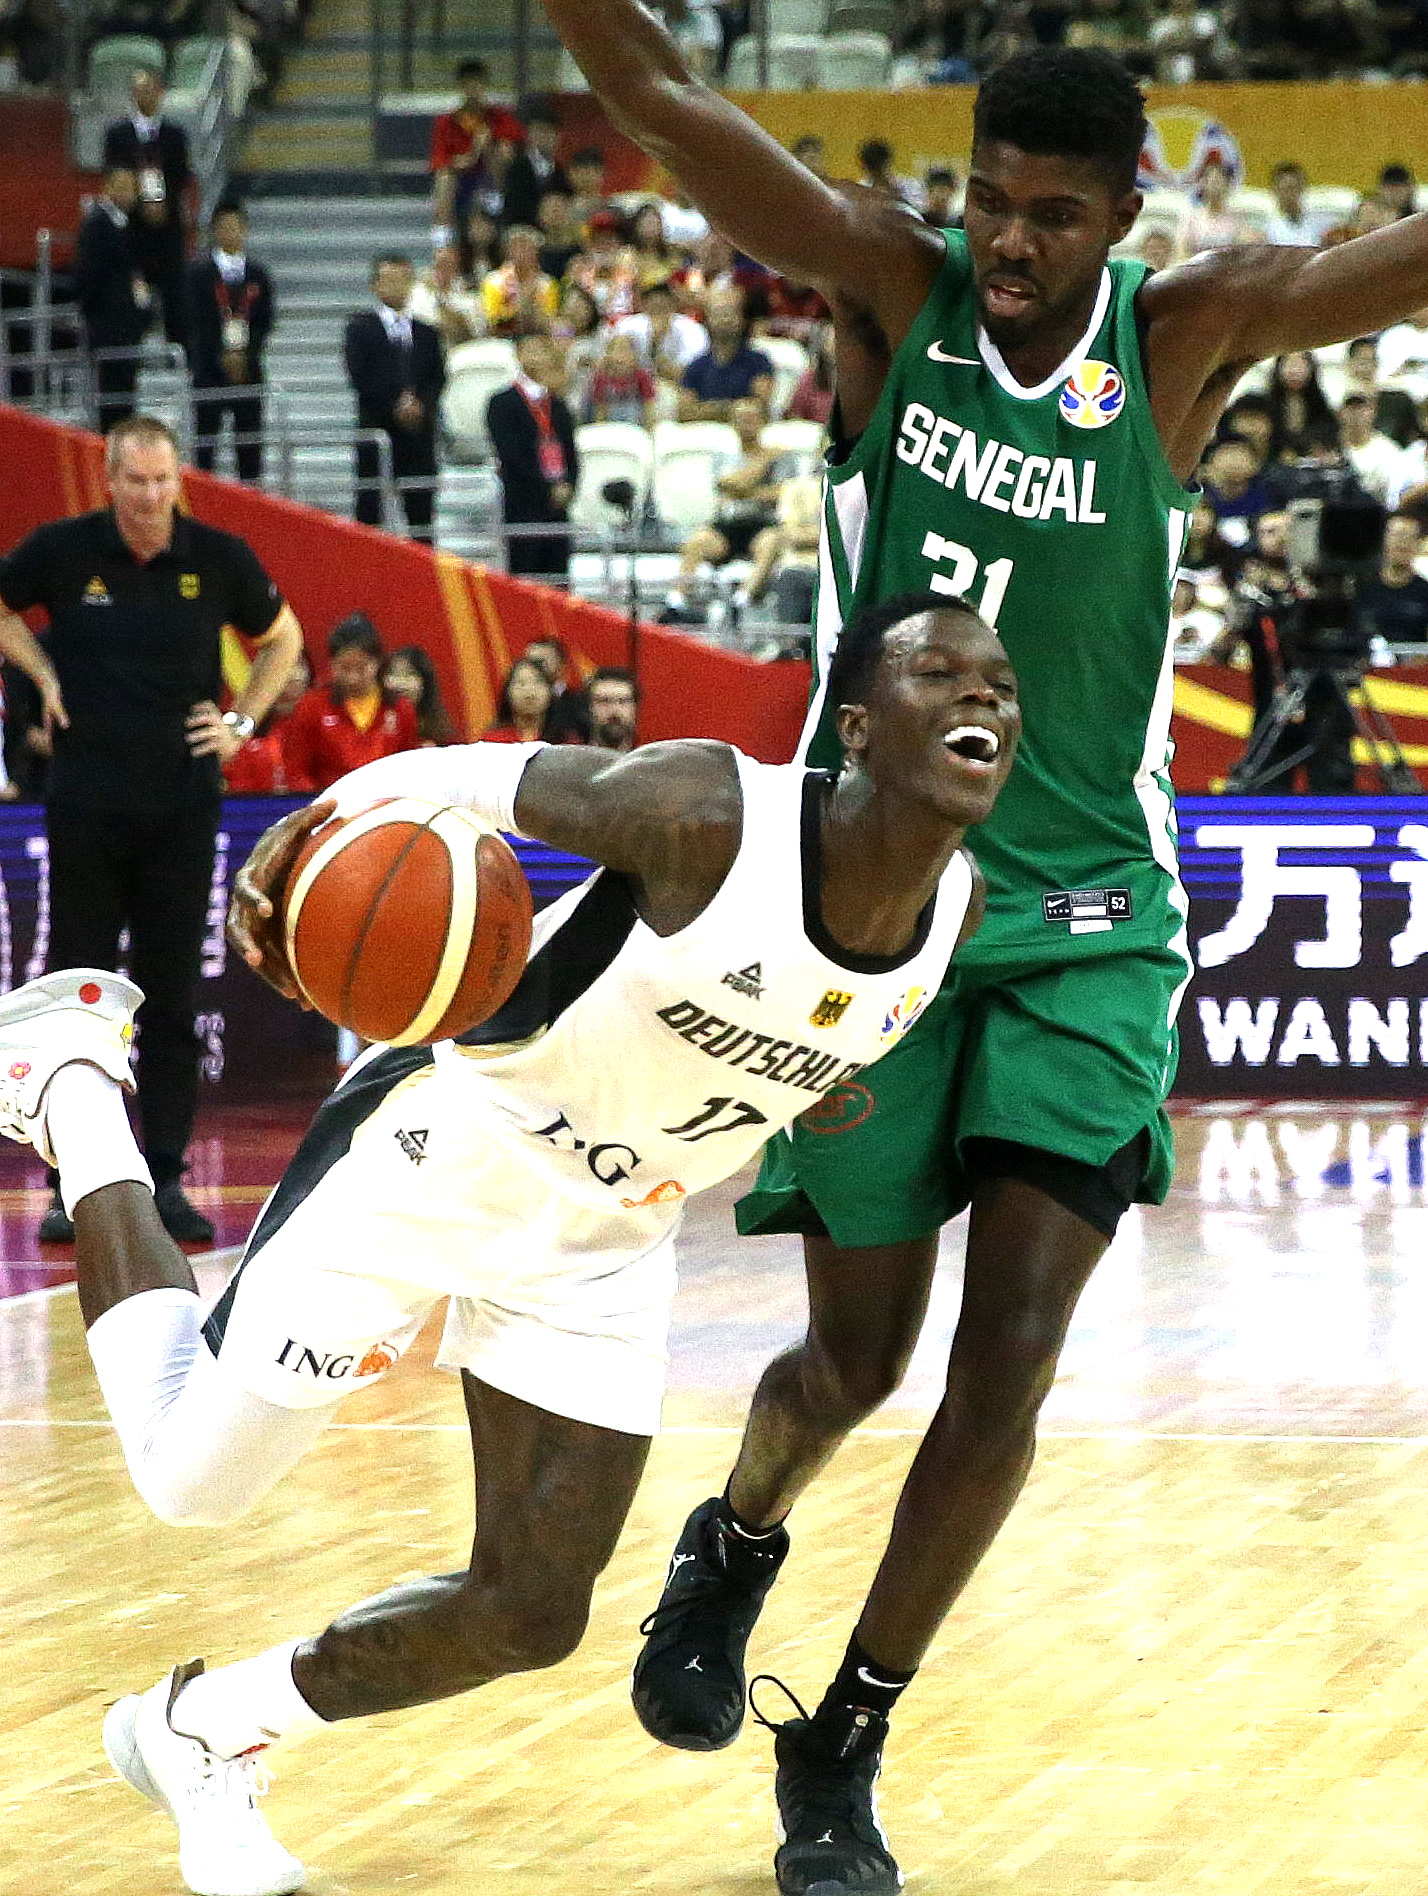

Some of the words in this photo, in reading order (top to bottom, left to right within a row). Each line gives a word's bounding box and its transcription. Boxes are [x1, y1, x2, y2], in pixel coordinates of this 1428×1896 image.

[896, 402, 1107, 524] SENEGAL
[1111, 896, 1126, 910] 52
[1196, 825, 1428, 969] 万
[1196, 997, 1428, 1067] WAN
[530, 1110, 643, 1187] IG
[661, 1096, 769, 1141] 17
[274, 1336, 355, 1380] ING
